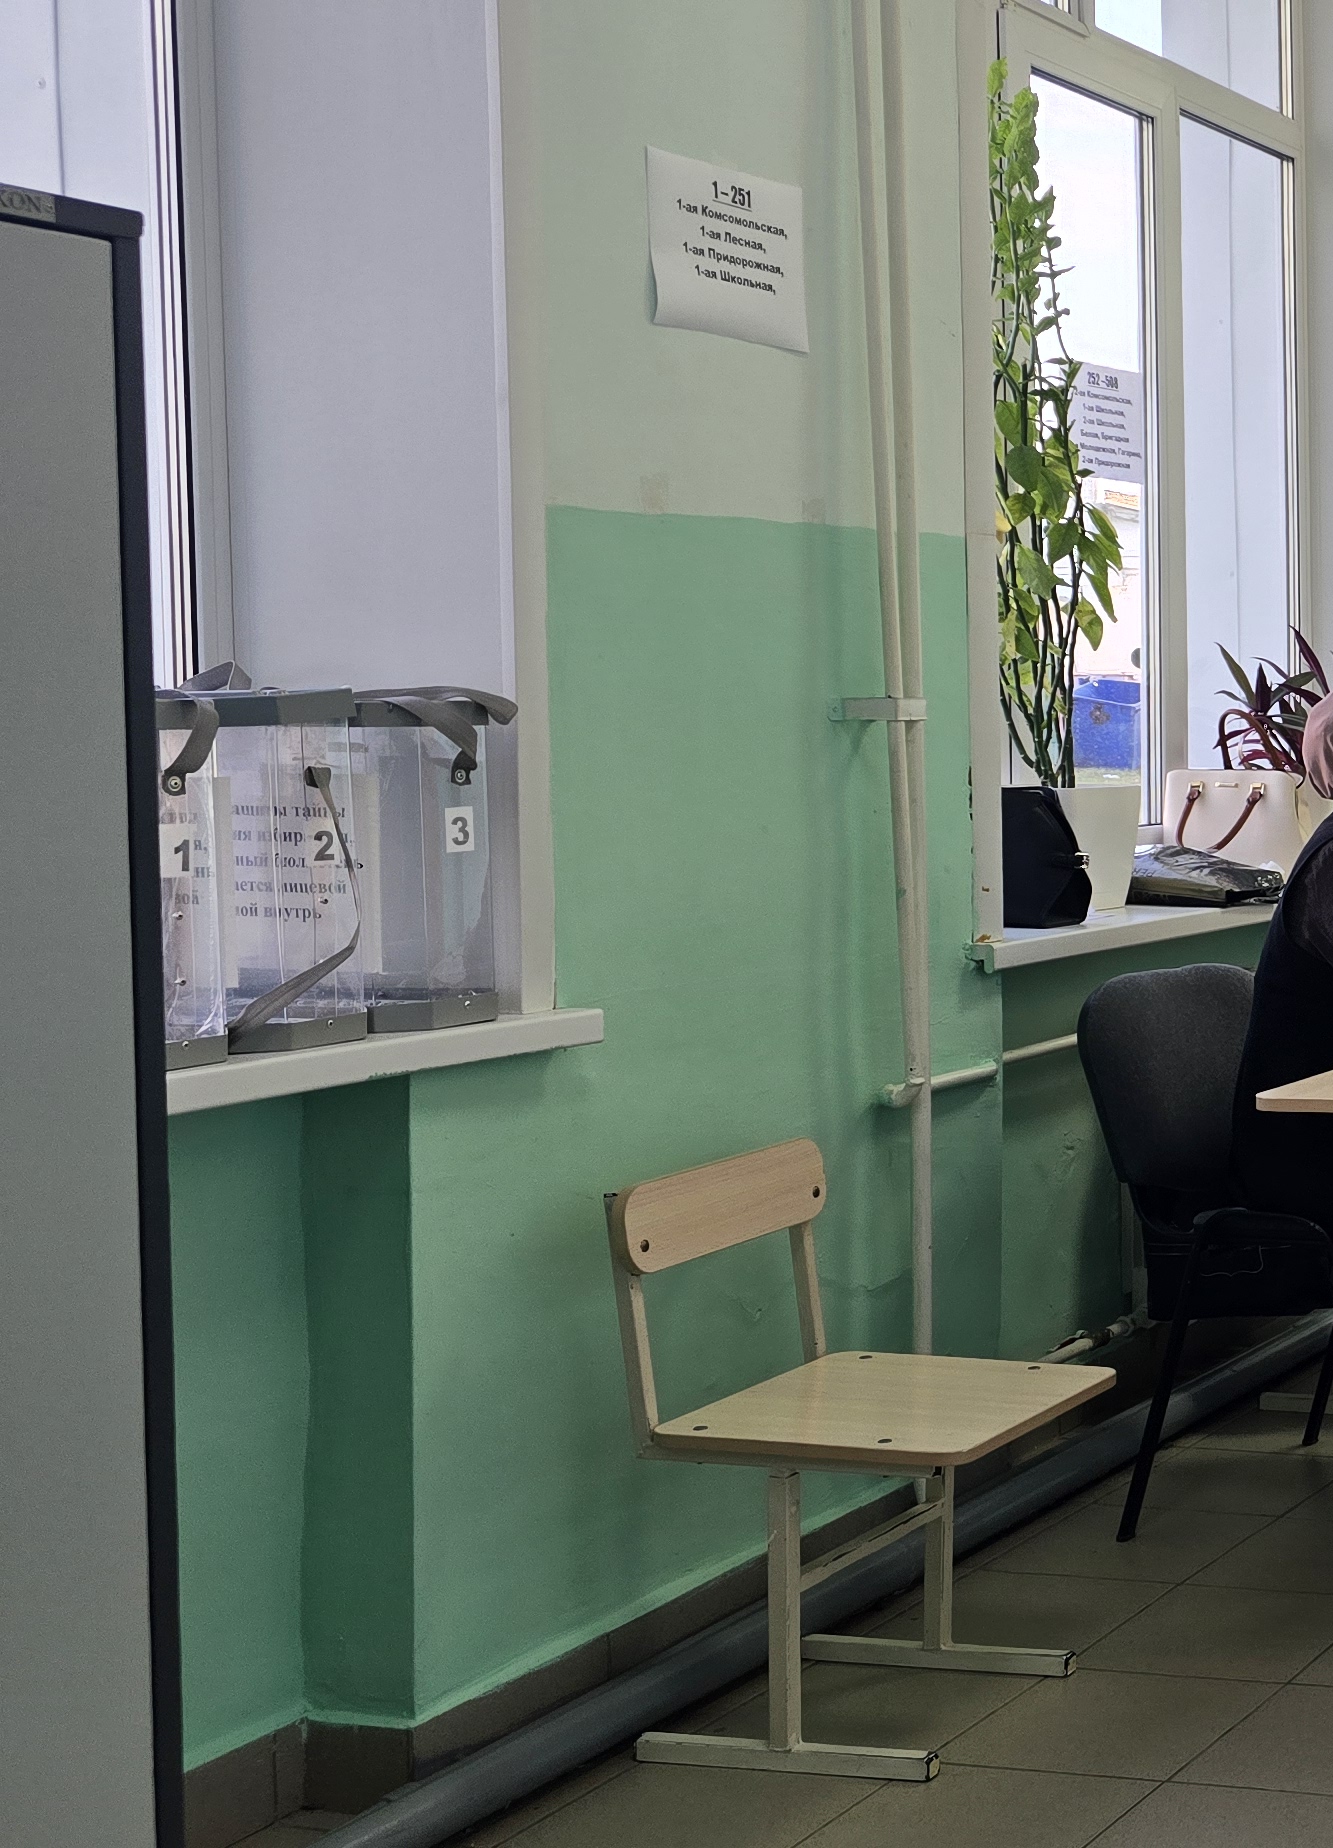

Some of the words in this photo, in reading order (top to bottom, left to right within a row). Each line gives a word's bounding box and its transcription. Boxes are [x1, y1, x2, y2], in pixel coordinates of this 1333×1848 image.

[677, 198, 698, 215] 1-ая
[701, 204, 788, 240] Комсомольская,
[700, 225, 721, 241] 1-ая
[724, 231, 766, 254] Лесная,
[683, 241, 705, 257] 1-ая
[708, 247, 784, 278] Придорожная,
[695, 264, 717, 280] 1-ая
[720, 270, 776, 295] Школьная,
[313, 830, 335, 862] 2
[450, 816, 470, 846] 3
[174, 839, 190, 872] 1
